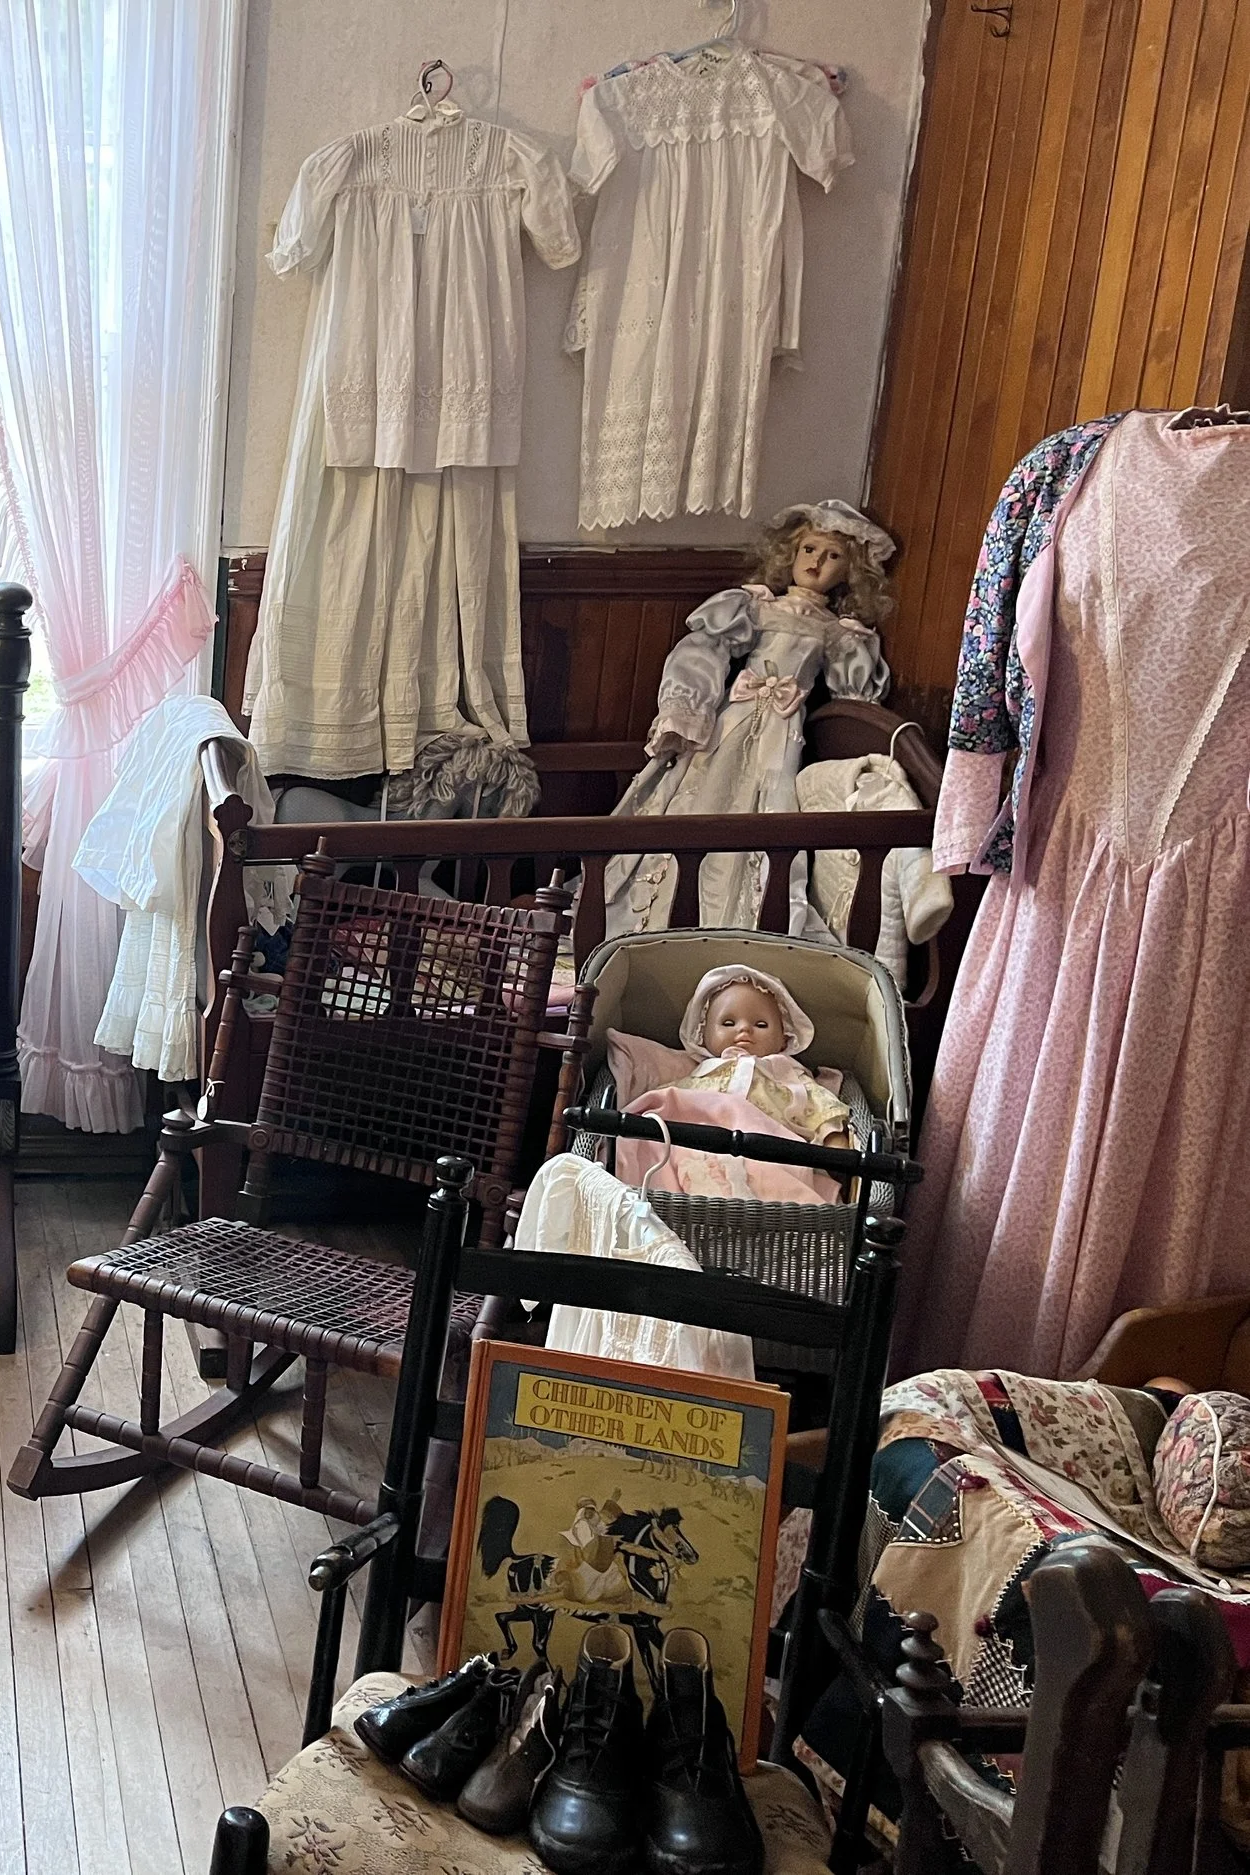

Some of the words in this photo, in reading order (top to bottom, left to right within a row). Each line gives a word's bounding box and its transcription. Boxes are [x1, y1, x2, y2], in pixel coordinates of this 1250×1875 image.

[529, 1405, 625, 1441] OTHER
[634, 1422, 725, 1460] LANDS
[532, 1379, 673, 1423] CHILDREN
[686, 1407, 727, 1432] OF
